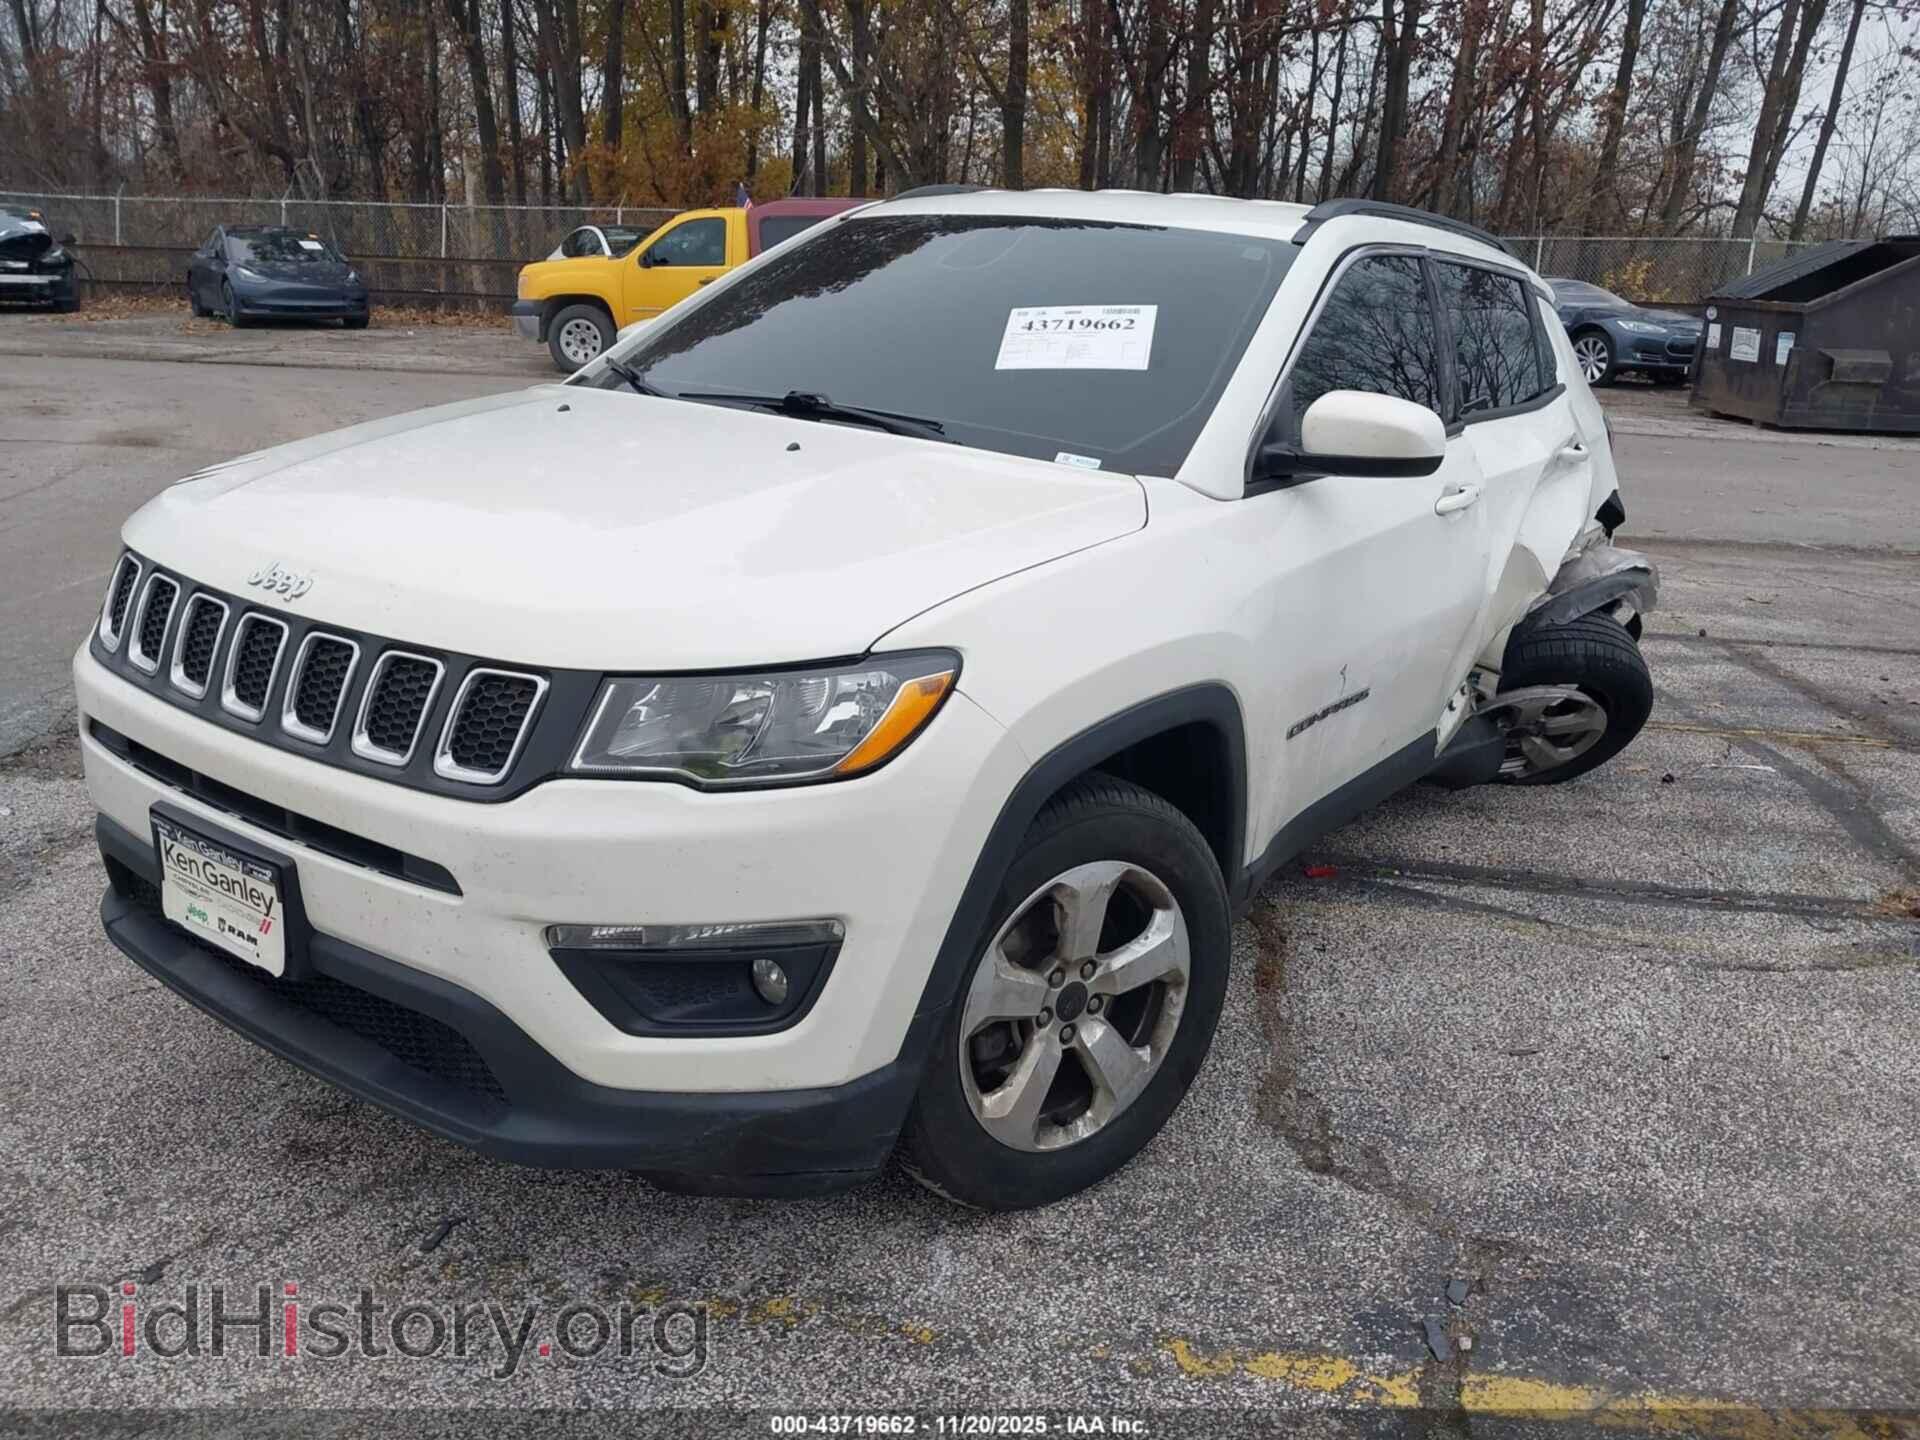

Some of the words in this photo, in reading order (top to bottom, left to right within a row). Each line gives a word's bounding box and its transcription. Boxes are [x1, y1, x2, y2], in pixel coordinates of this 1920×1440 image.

[1021, 318, 1136, 331] 43719662
[248, 560, 314, 602] Jeep
[162, 838, 200, 878] Ken
[202, 861, 274, 917] Ganley
[227, 924, 258, 947] RAM
